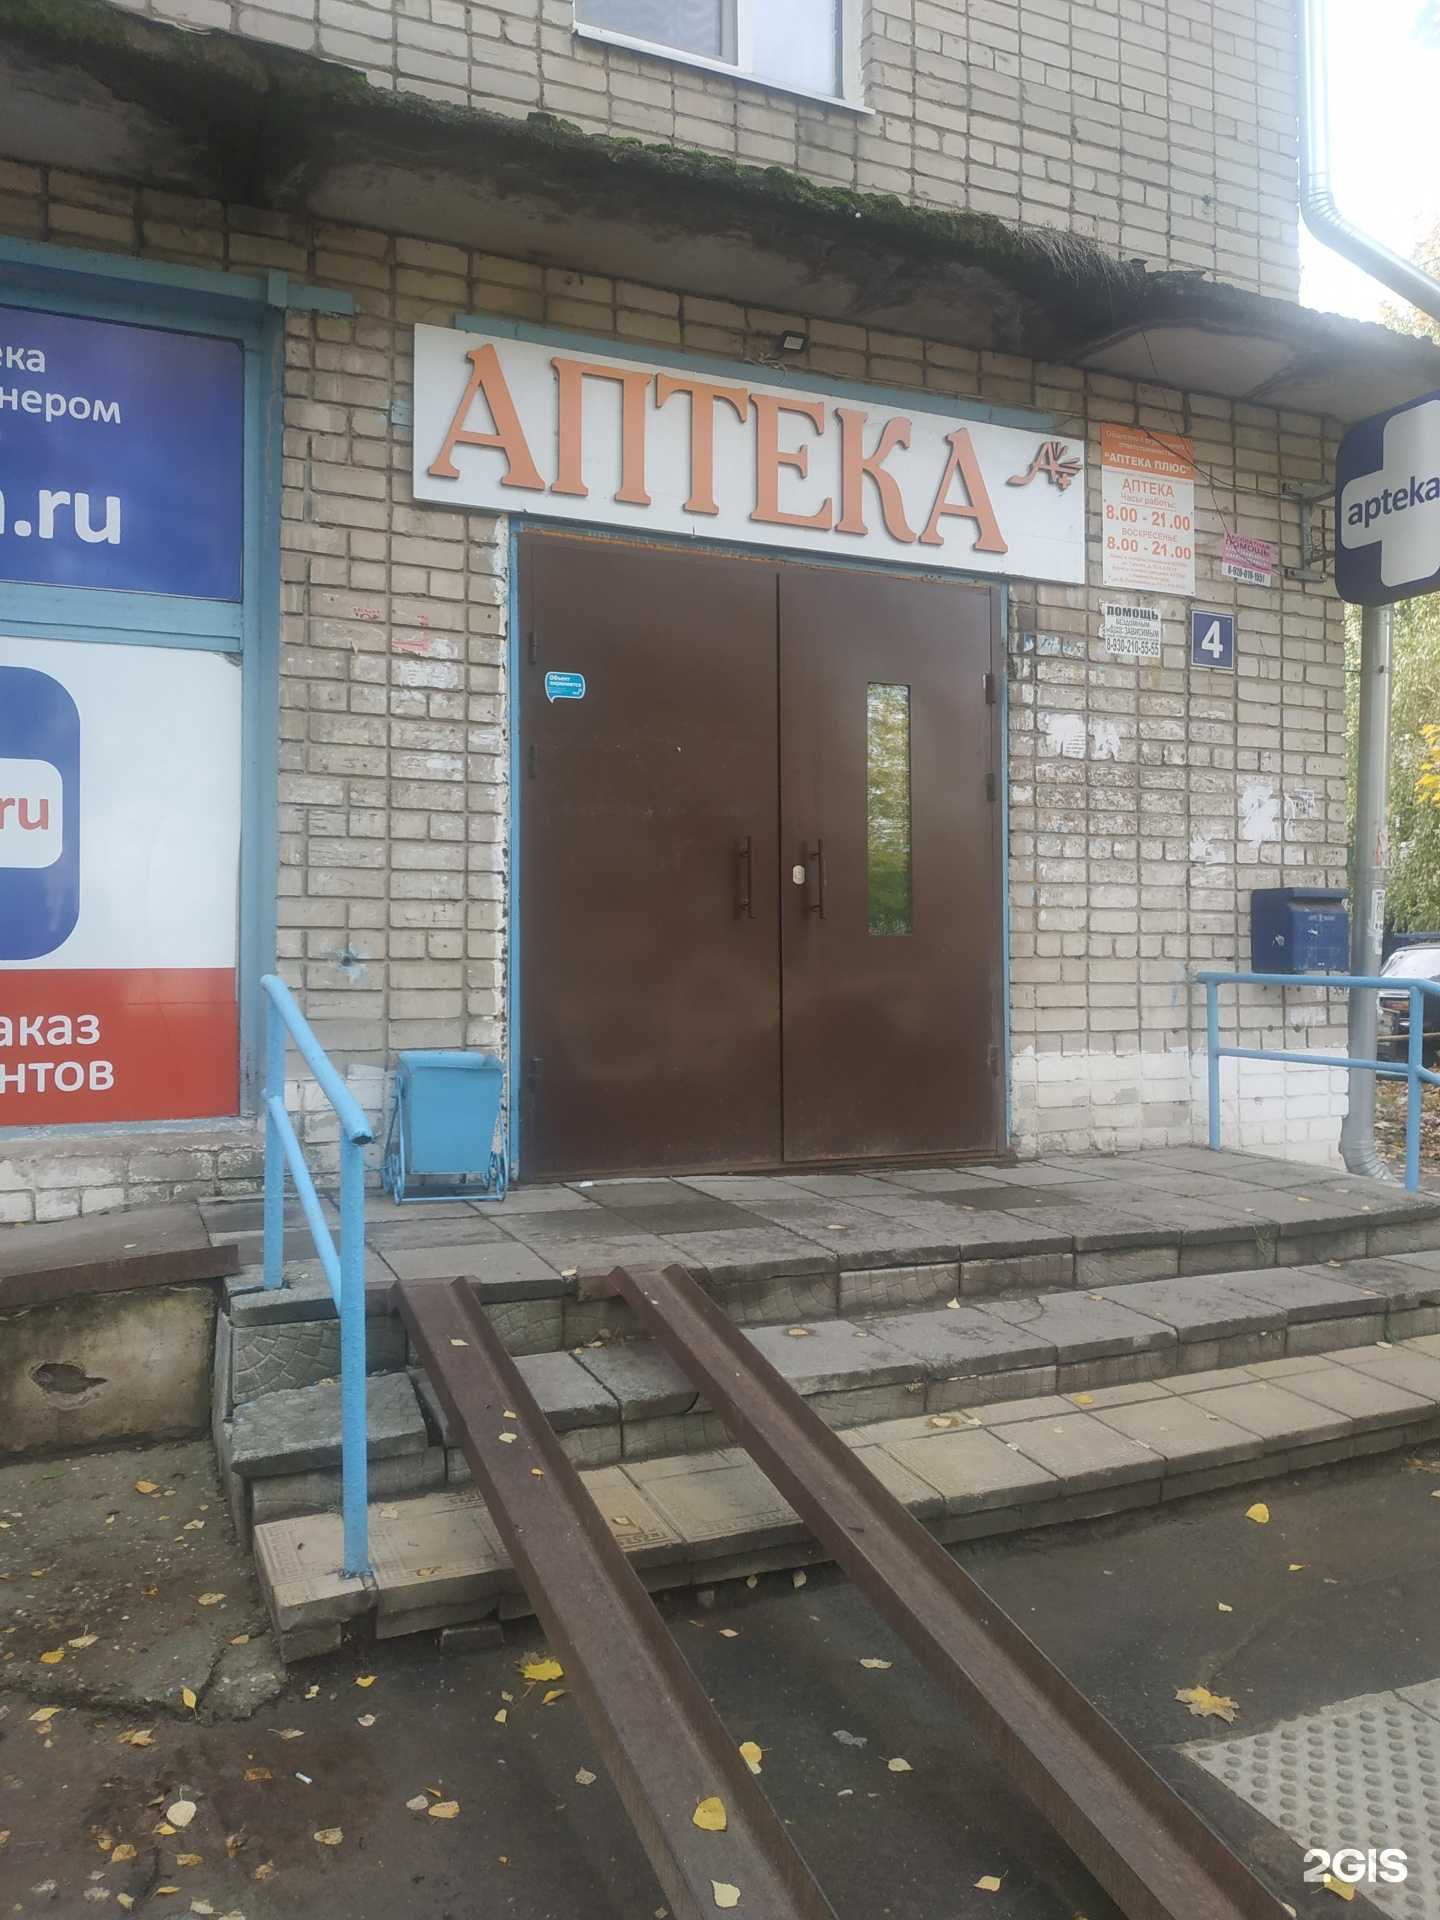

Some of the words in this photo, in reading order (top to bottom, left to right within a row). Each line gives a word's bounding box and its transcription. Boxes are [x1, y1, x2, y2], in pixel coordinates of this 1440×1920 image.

[0, 346, 46, 373] ка
[428, 343, 1008, 553] АПТЕКА
[1122, 479, 1175, 498] АПТЕКА
[1348, 475, 1440, 528] apteka
[0, 489, 121, 545] .ru
[1106, 504, 1138, 523] 8.00
[1151, 511, 1190, 531] 21.00
[1107, 536, 1138, 553] 8.00
[1151, 540, 1192, 560] 21.00
[1106, 605, 1159, 621] ПОМОЩЬ
[1106, 637, 1159, 656] 8-930-210-55-55
[1201, 620, 1223, 659] 4
